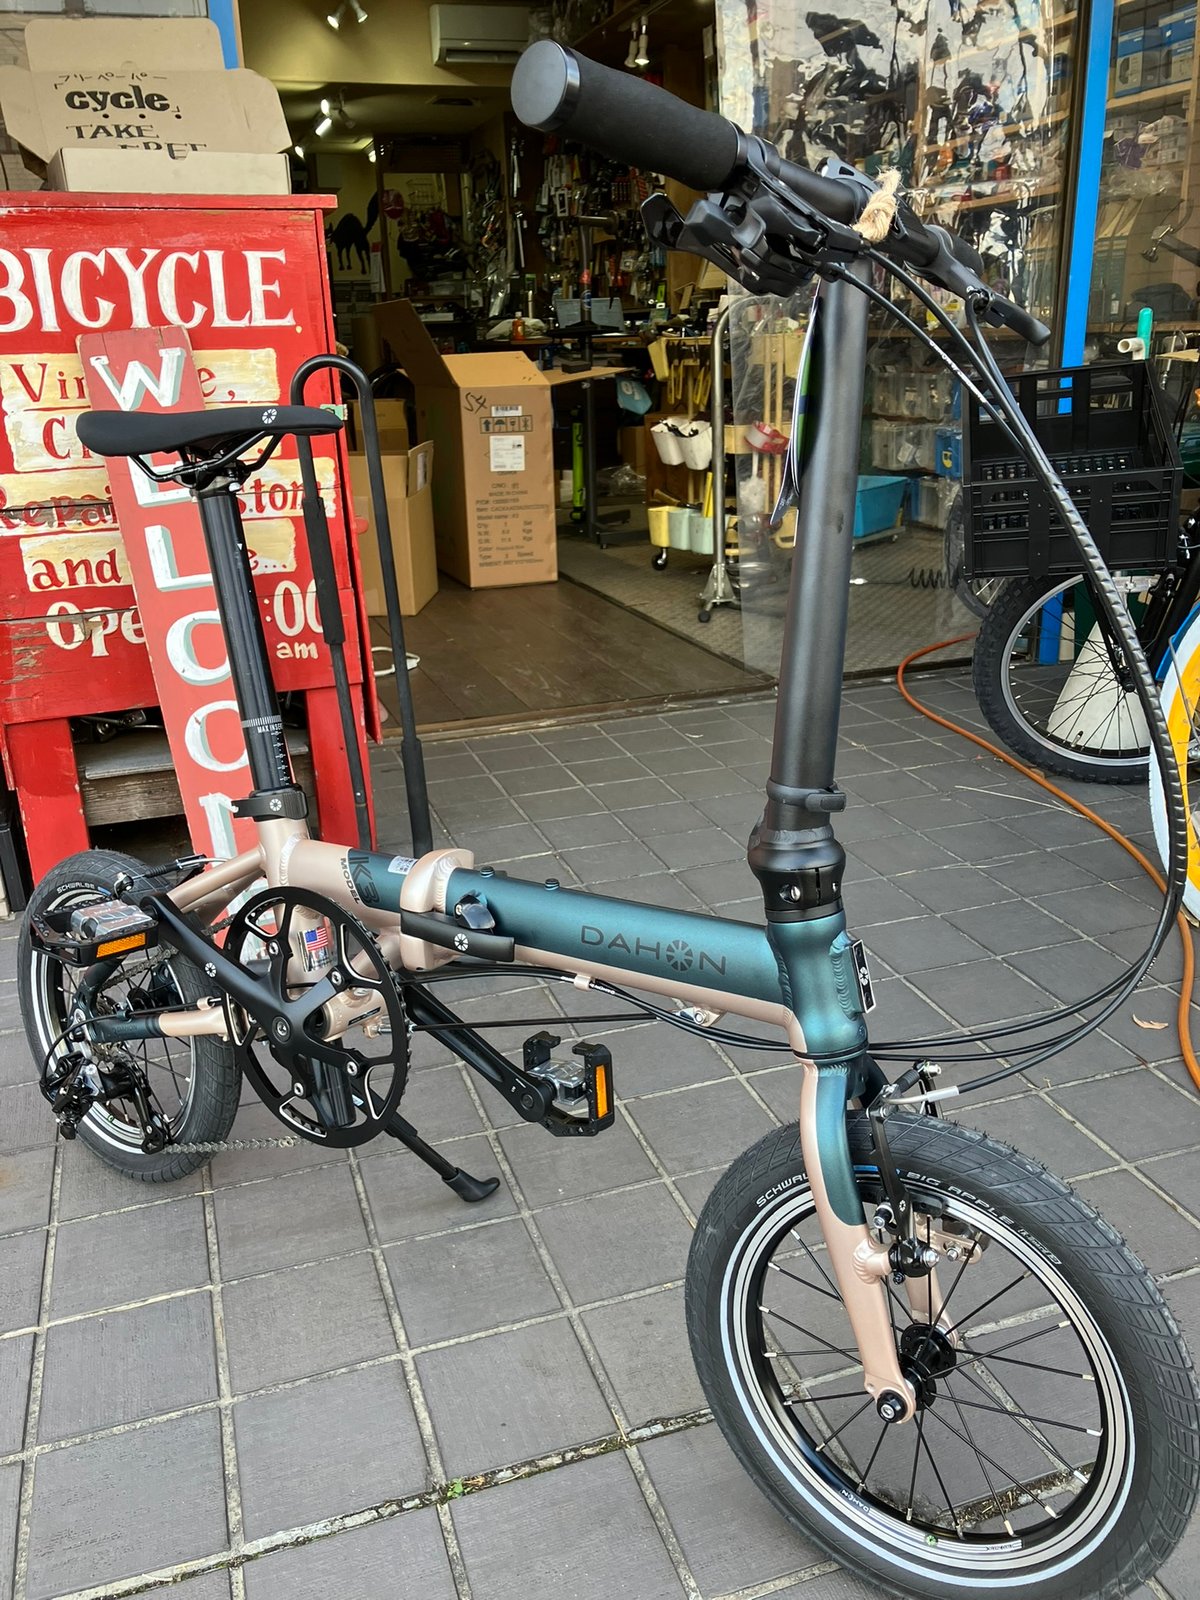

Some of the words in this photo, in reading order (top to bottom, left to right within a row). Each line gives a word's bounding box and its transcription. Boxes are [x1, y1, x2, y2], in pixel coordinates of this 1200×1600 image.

[66, 124, 159, 139] TAKE
[32, 549, 123, 590] and
[46, 601, 146, 657] Ope
[276, 642, 319, 660] am
[256, 724, 276, 734] MAX
[340, 857, 360, 905] MODEL
[580, 925, 726, 976] DAHON
[756, 1173, 809, 1208] SCHWAL
[906, 1171, 942, 1187] BIG
[948, 1185, 1015, 1226] APPLE
